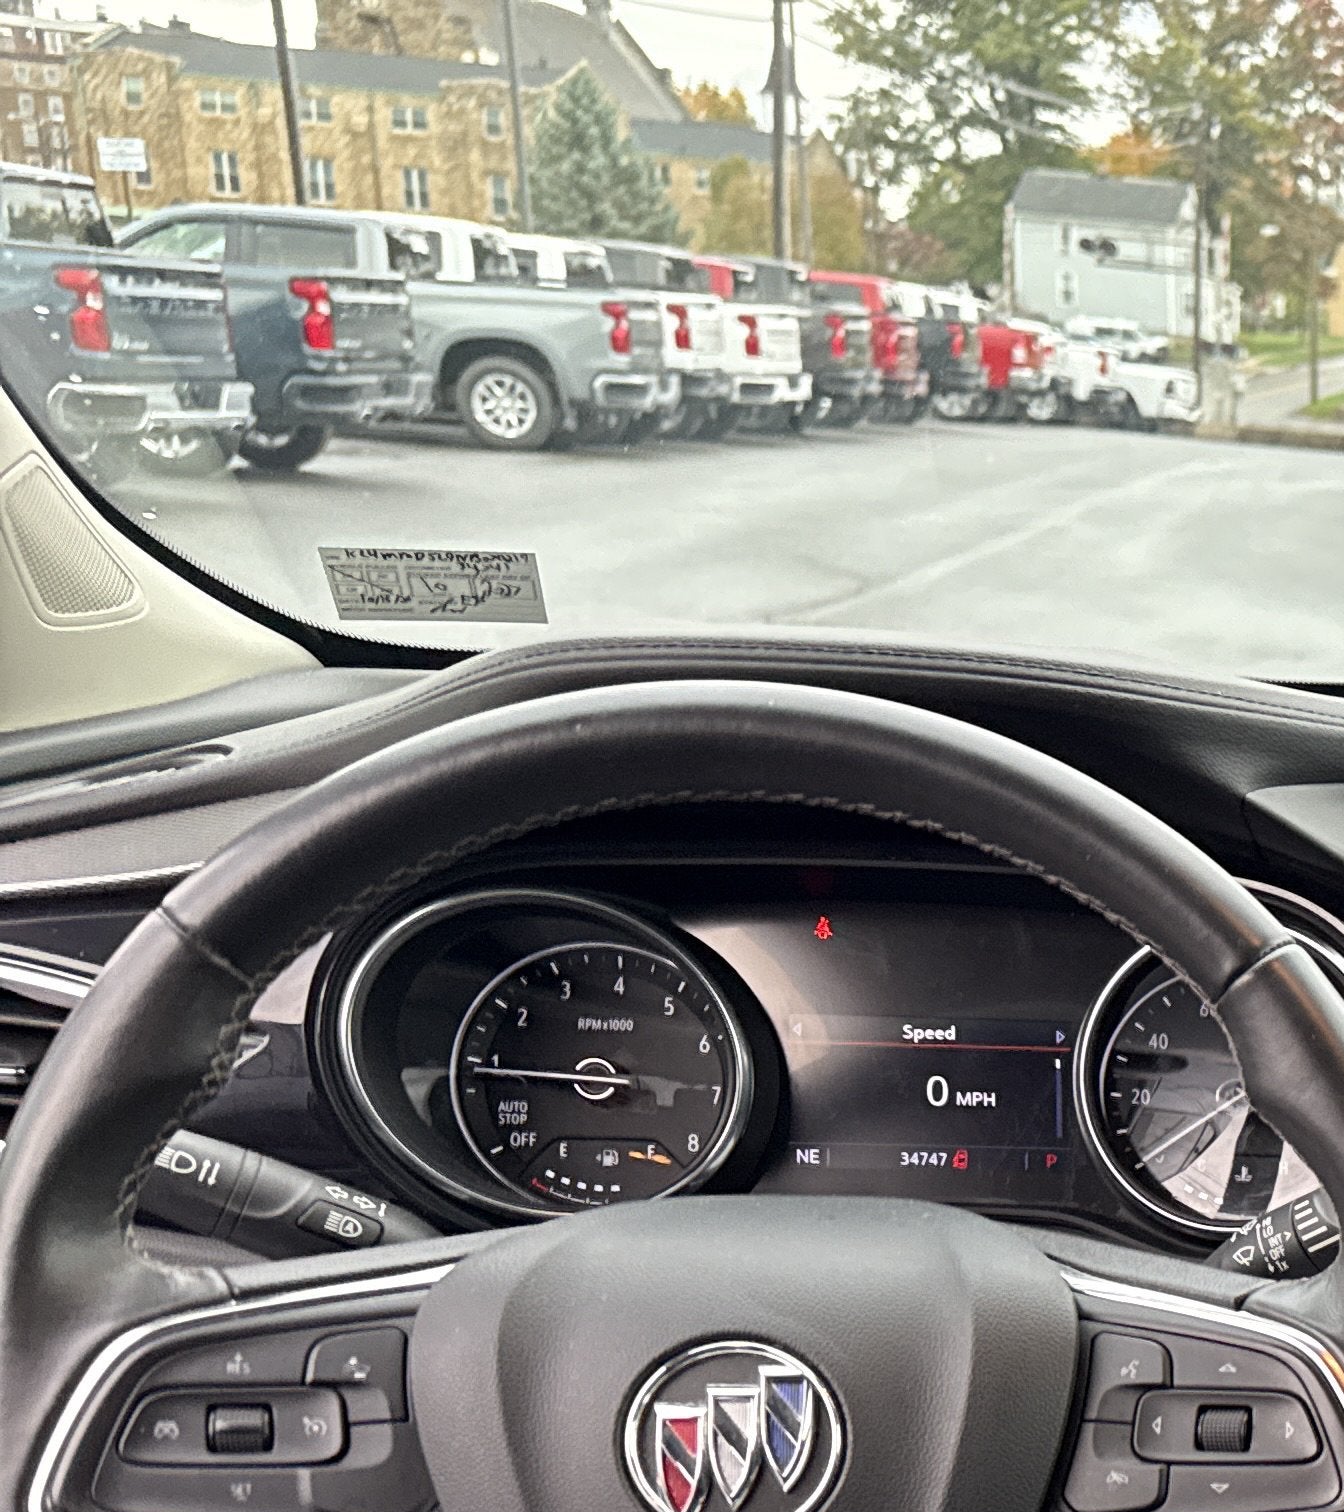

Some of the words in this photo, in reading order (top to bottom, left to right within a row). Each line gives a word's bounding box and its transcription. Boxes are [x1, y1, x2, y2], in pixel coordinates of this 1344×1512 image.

[560, 981, 571, 1000] 3
[614, 976, 625, 995] 4
[664, 997, 675, 1016] 5
[517, 1008, 528, 1027] 2
[902, 1024, 956, 1043] Speed
[1149, 1033, 1168, 1050] 40
[699, 1035, 710, 1054] 6
[490, 1054, 499, 1067] 1
[711, 1086, 722, 1105] 7
[926, 1075, 949, 1107] 0
[956, 1092, 996, 1107] MPH
[1131, 1089, 1150, 1105] 20
[498, 1101, 528, 1113] AUTO
[498, 1113, 528, 1125] STOP
[510, 1132, 537, 1147] OFF
[688, 1133, 699, 1152] 8
[560, 1142, 568, 1158] E
[647, 1144, 655, 1158] F
[796, 1149, 820, 1164] NE
[900, 1152, 947, 1167] 34747
[1262, 1226, 1273, 1238] LO
[1269, 1246, 1285, 1260] OFF
